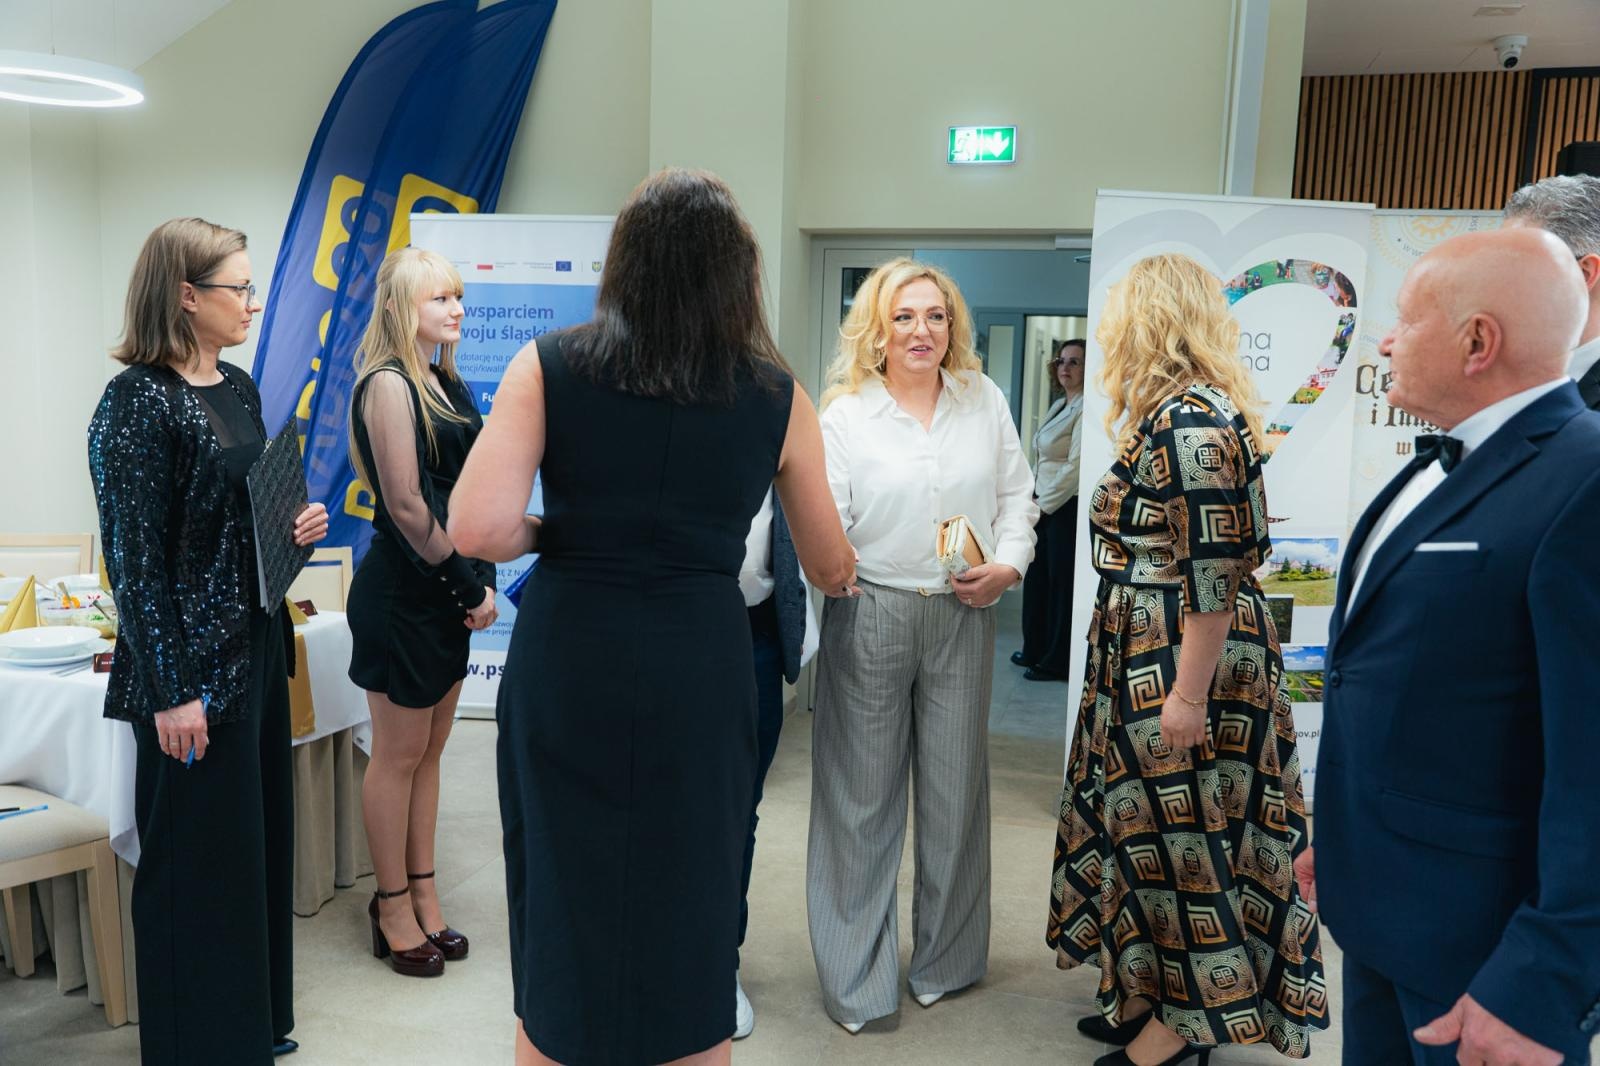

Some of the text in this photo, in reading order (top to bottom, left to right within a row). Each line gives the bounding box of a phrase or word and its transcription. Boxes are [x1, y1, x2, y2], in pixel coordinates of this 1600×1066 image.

[464, 304, 554, 322] wsparciem
[461, 325, 496, 343] woju
[1239, 332, 1271, 350] na
